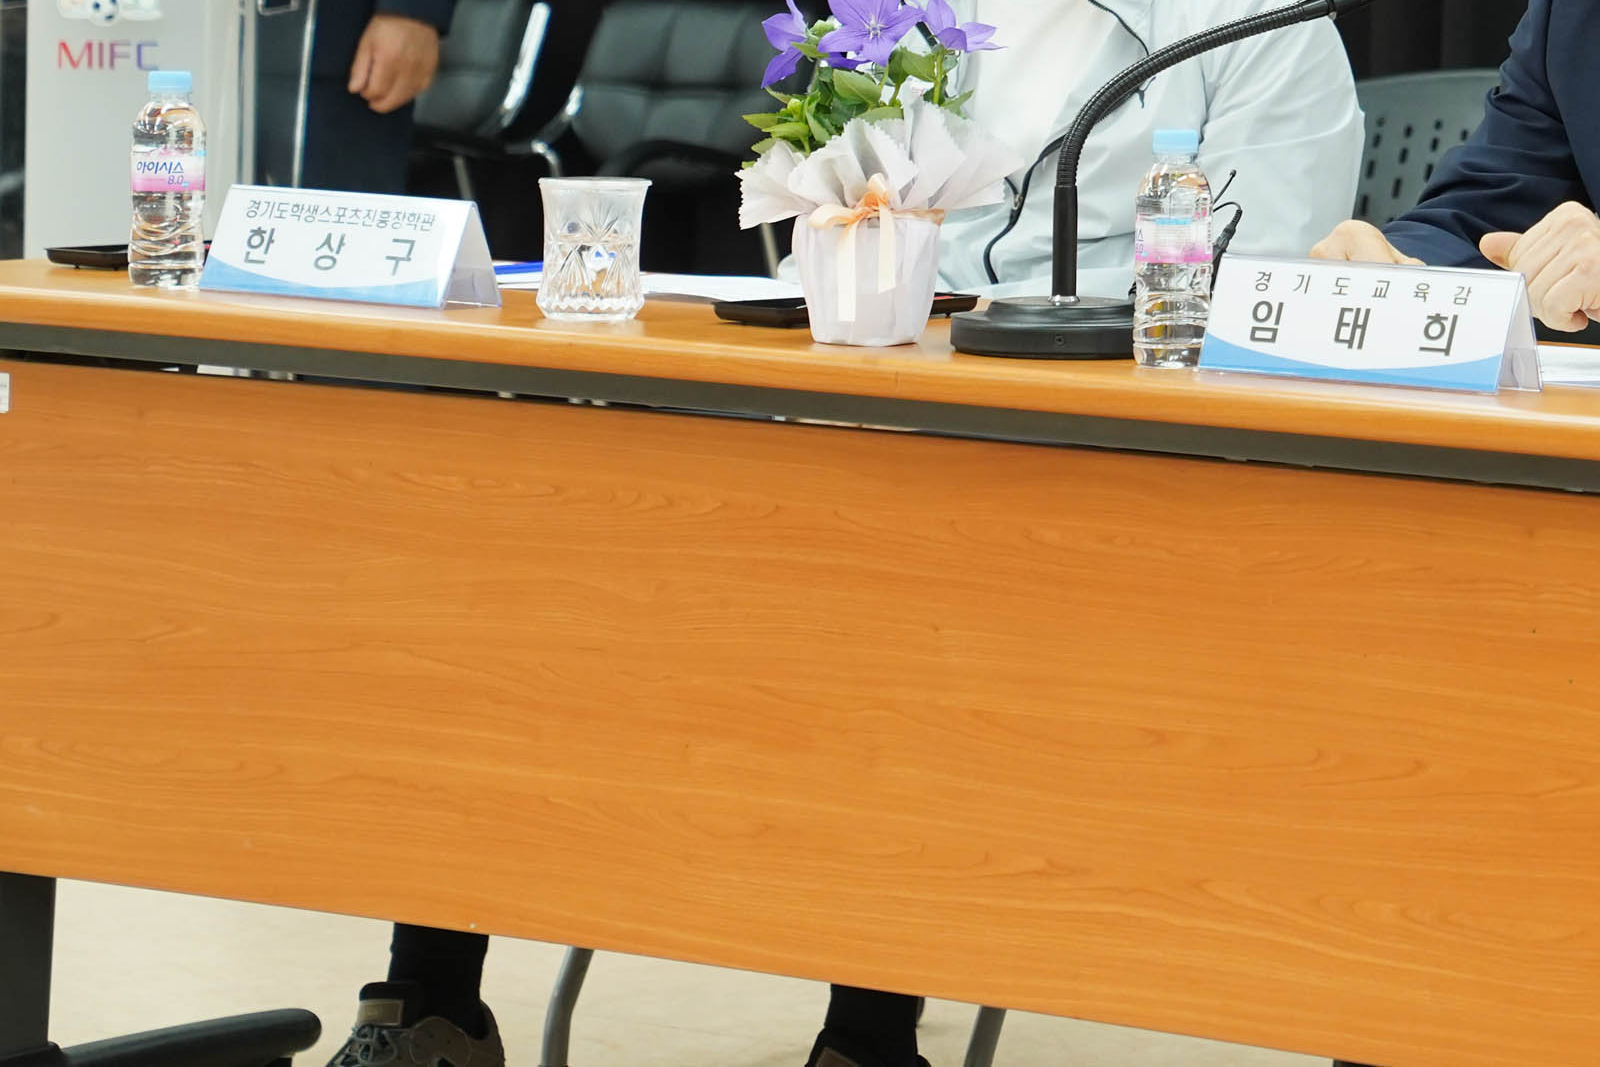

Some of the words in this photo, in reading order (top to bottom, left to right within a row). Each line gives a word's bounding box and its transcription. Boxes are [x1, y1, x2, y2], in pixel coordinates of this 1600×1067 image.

[58, 40, 160, 71] MIFC
[136, 161, 184, 174] 아이시스
[167, 175, 184, 185] 8.0
